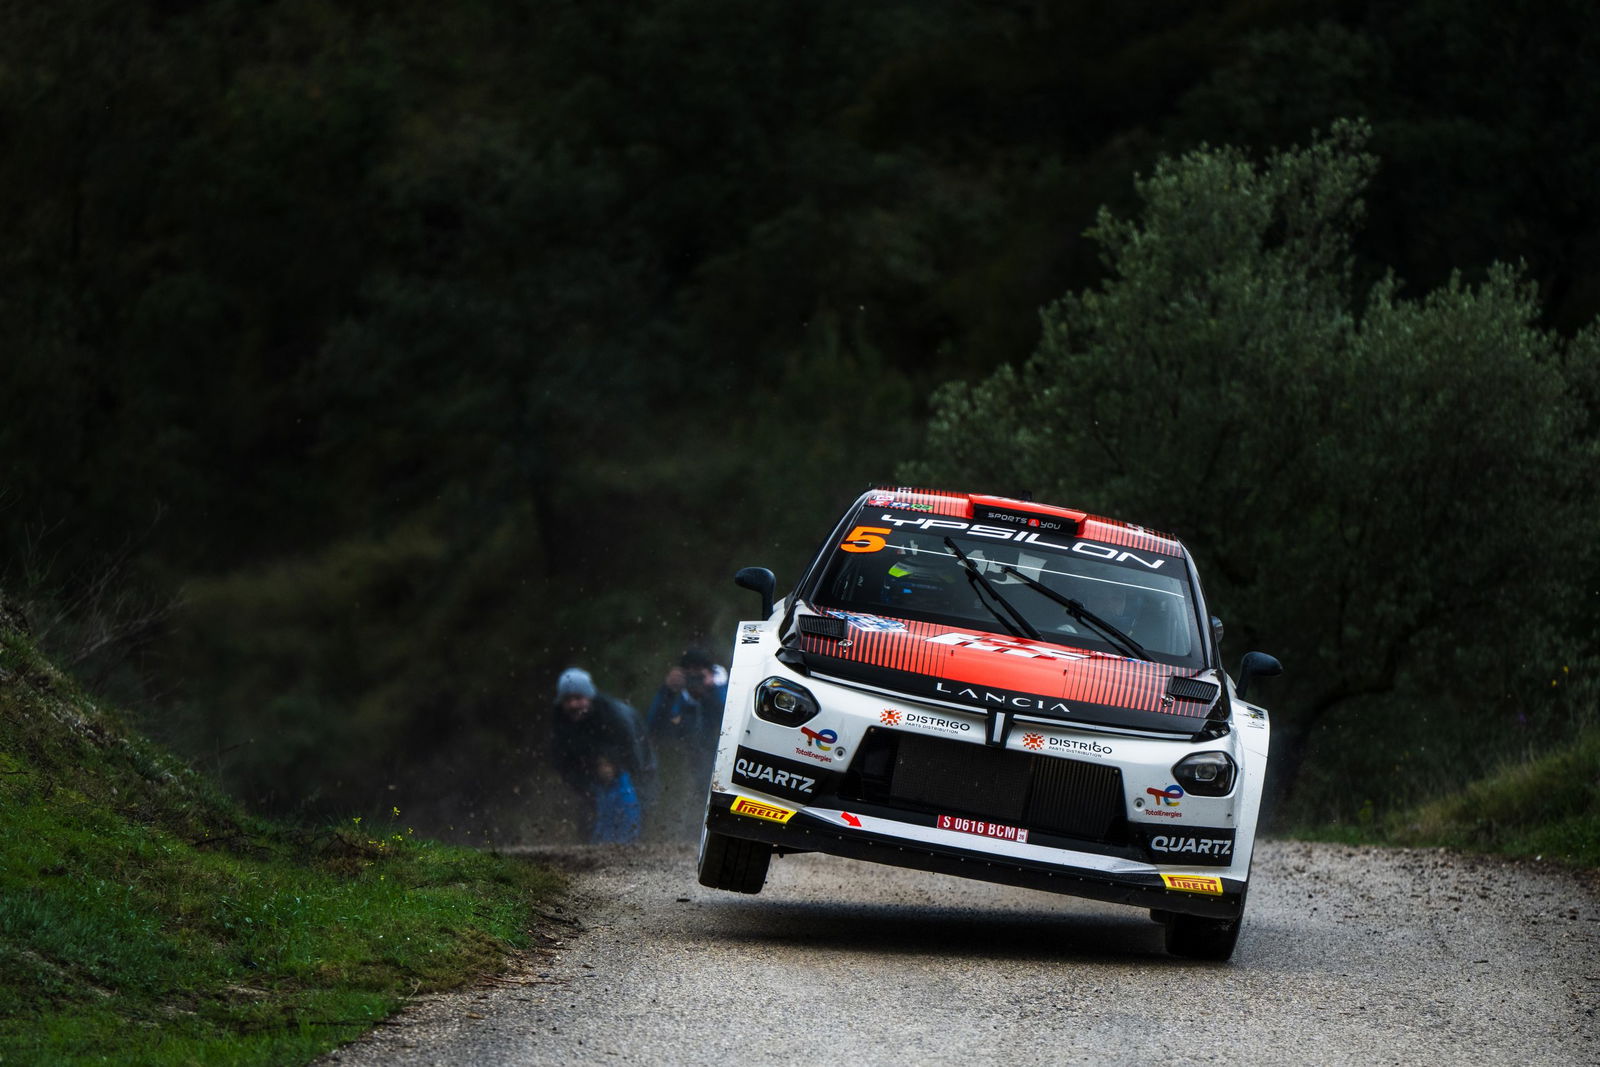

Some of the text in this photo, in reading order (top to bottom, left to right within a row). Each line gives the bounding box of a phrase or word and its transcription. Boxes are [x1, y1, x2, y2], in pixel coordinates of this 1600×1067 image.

[988, 512, 1027, 524] SPORTS
[1040, 521, 1061, 530] YOU
[840, 526, 892, 553] 5
[881, 514, 1165, 569] YPSILON
[936, 682, 1071, 713] LANCIA
[906, 713, 971, 732] DISTRIGO
[922, 724, 959, 735] DISTRIBUTION
[795, 747, 832, 763] TotalEnergies
[1049, 737, 1113, 755] DISTRIGO
[1066, 748, 1102, 758] DISTRIBUTION
[735, 758, 816, 794] QUARTZ
[736, 800, 789, 820] PIRELLI
[1145, 809, 1182, 819] TotalEnergies
[943, 815, 1016, 840] S 0616 BCM
[1151, 835, 1232, 855] QUARTZ
[1167, 876, 1218, 893] PIRELLI
